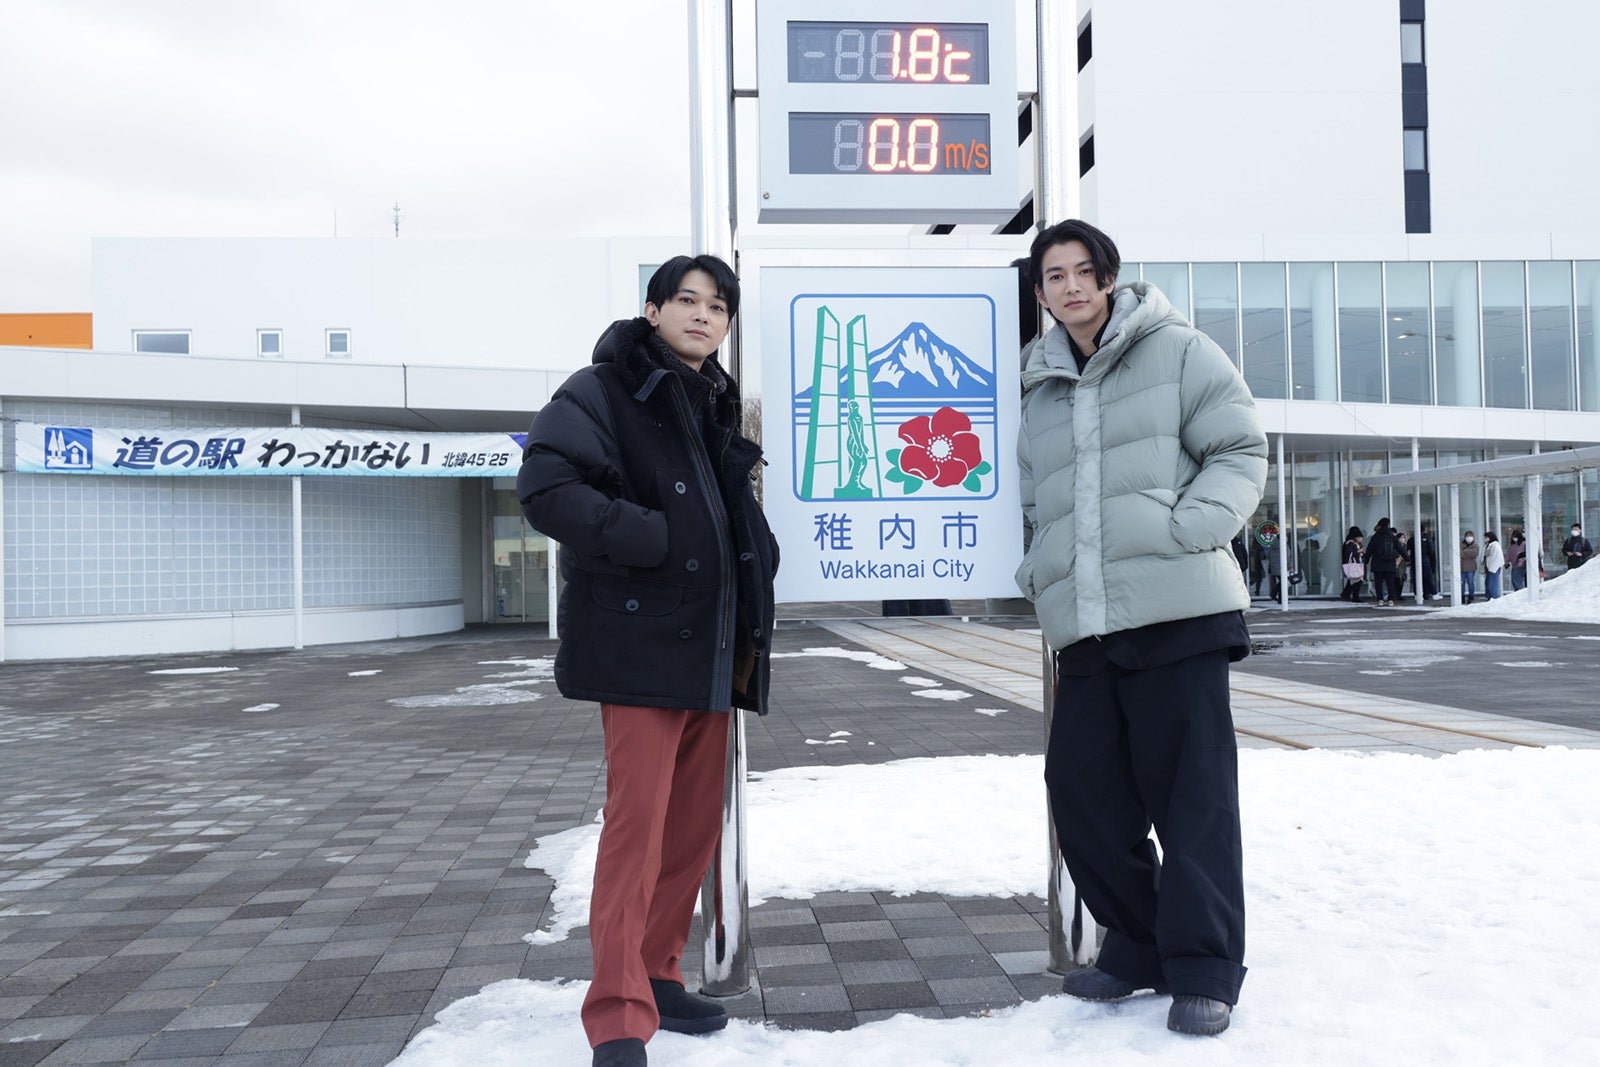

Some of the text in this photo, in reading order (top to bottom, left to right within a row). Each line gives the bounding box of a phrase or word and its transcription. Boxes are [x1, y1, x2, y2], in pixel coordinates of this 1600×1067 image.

[944, 139, 989, 171] m/s
[112, 436, 246, 470] 道の駅
[256, 438, 430, 470] わっかない
[813, 511, 979, 551] 稚内市
[819, 558, 975, 582] Wakkanai City
